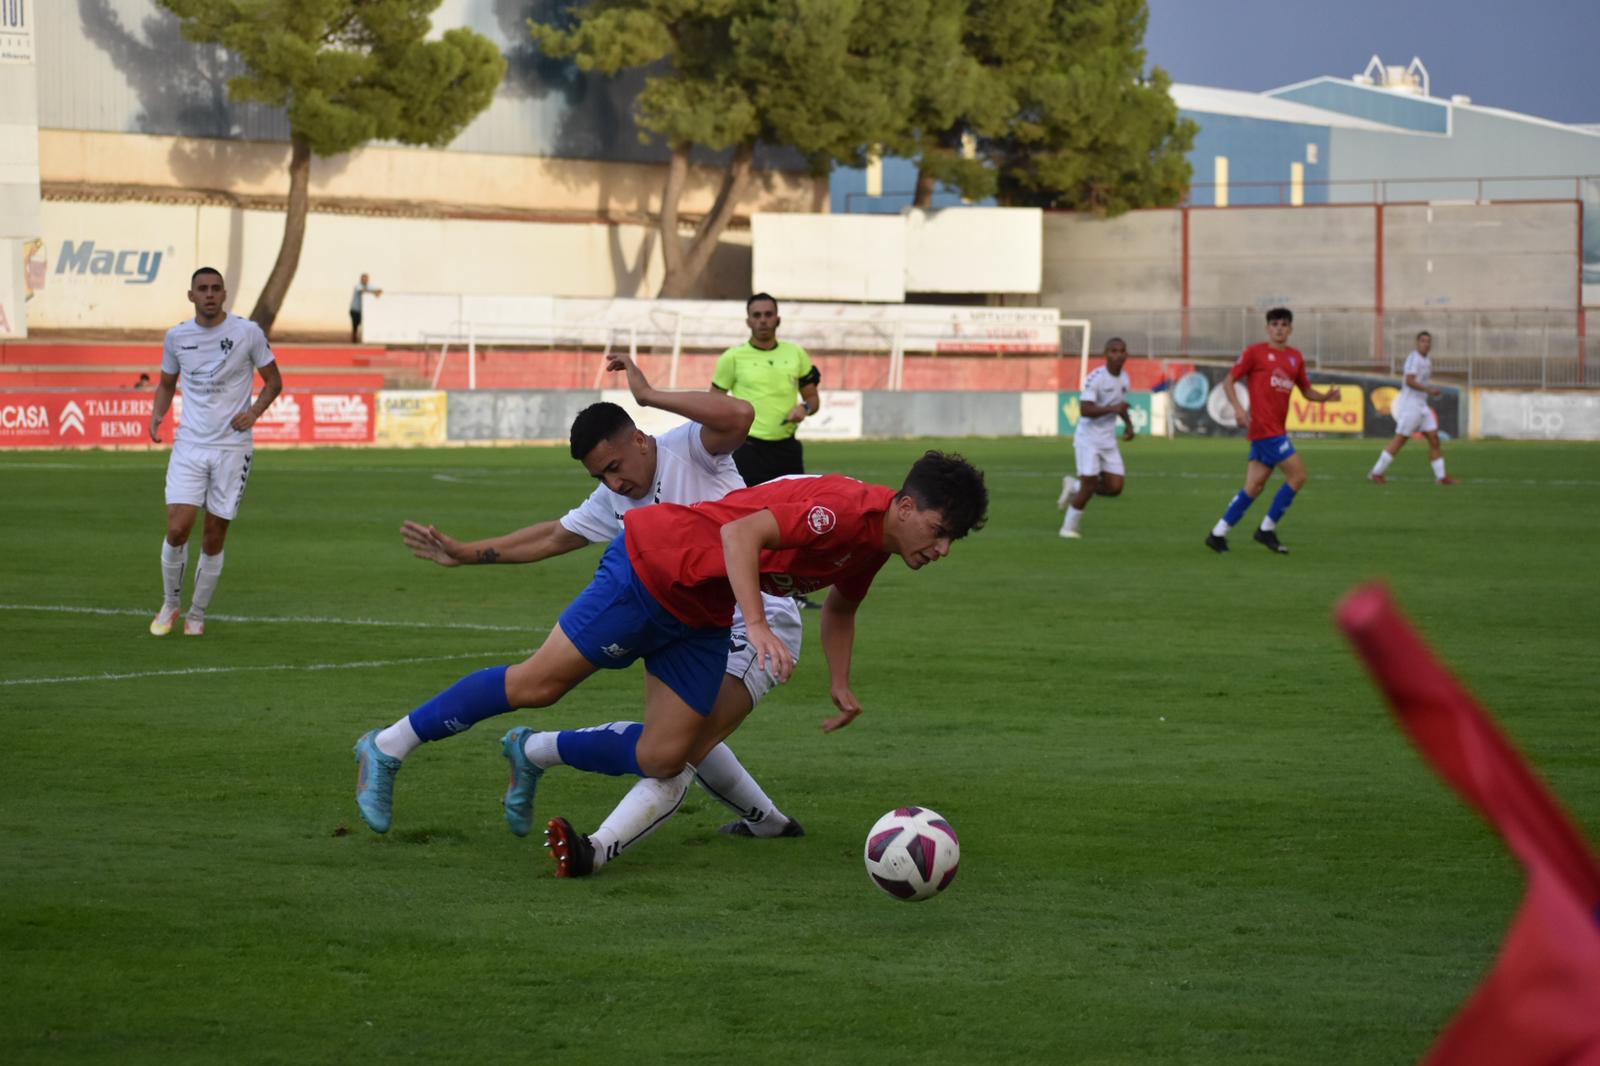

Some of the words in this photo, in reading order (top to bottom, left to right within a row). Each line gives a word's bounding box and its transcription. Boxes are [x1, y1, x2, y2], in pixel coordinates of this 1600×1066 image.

[55, 240, 163, 284] Macy
[0, 405, 49, 428] CASA
[85, 399, 153, 416] TALLERES
[1294, 401, 1357, 424] Vitra
[100, 421, 142, 437] REMO
